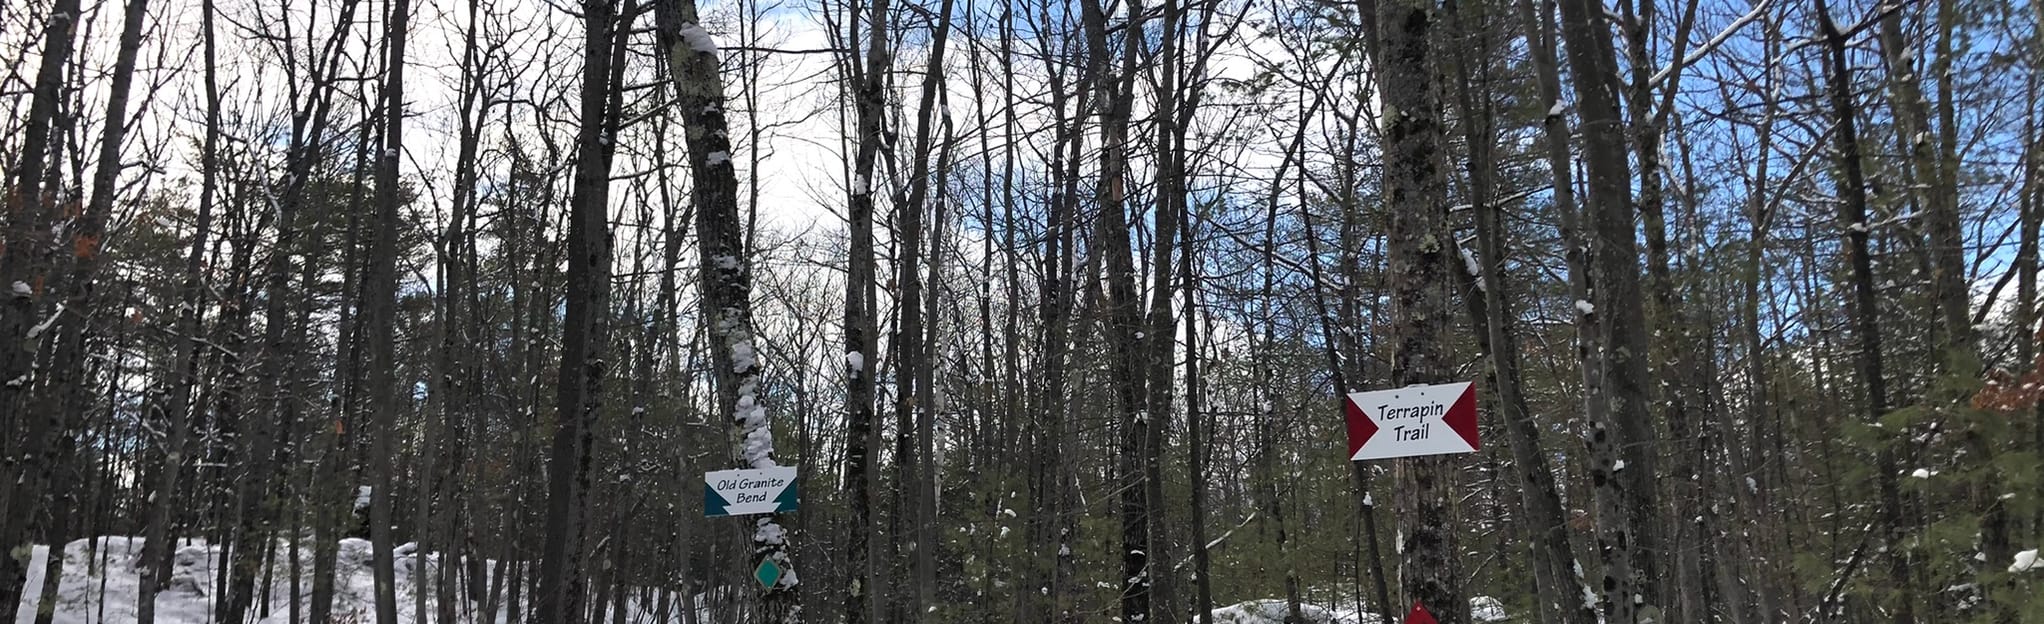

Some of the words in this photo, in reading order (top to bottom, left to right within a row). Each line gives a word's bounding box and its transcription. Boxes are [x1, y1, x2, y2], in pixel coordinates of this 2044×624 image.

[1378, 400, 1443, 423] Terrapin
[1394, 423, 1430, 441] Trail
[717, 479, 736, 491] Old
[738, 477, 784, 490] Granite
[736, 492, 767, 503] Bend
